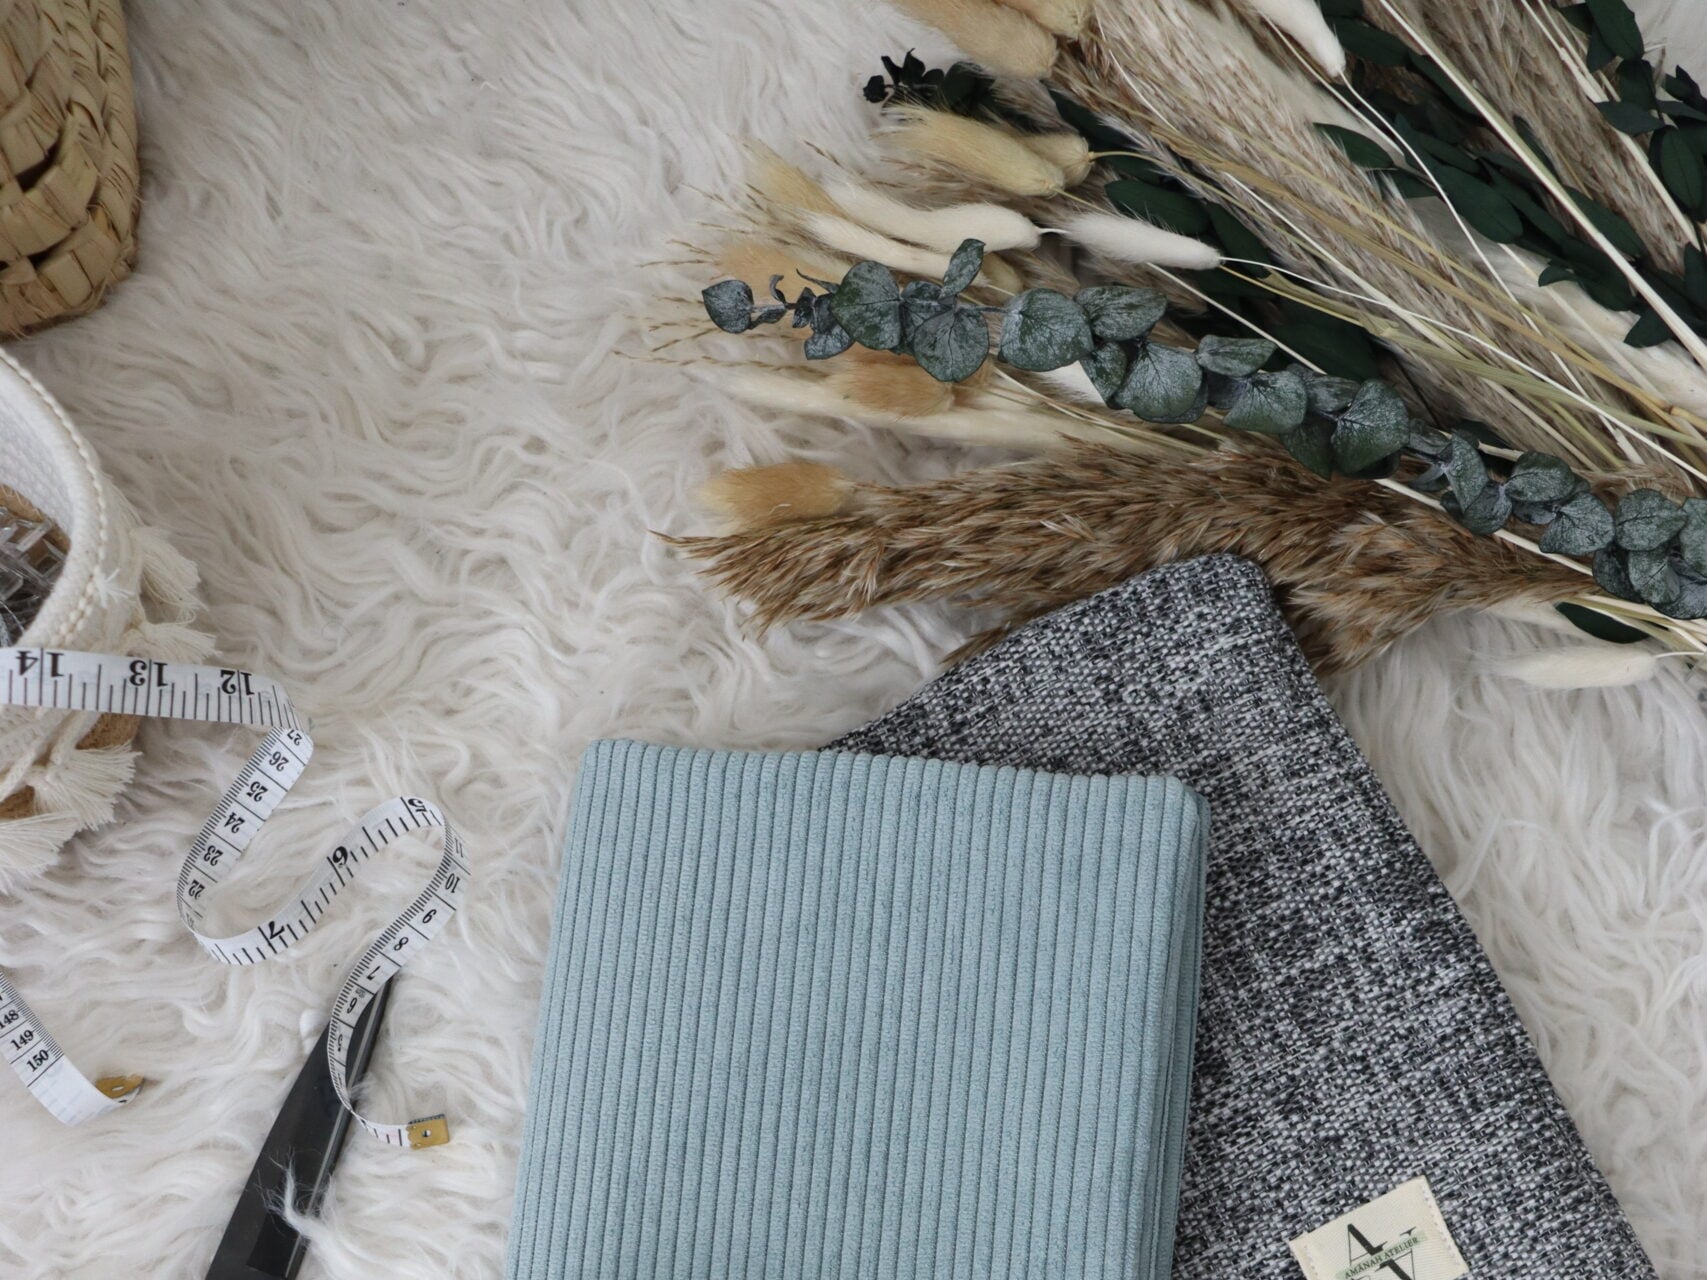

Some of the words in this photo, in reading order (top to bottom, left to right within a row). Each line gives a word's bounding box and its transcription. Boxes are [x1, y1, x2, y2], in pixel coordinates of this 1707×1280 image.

[16, 651, 64, 678] 14
[129, 659, 169, 687] 13
[220, 669, 255, 696] 12
[287, 729, 302, 746] 27
[269, 751, 289, 772] 26
[246, 781, 268, 802] 25
[224, 812, 245, 833] 24
[203, 845, 223, 866] 23
[188, 879, 205, 900] 22
[445, 873, 461, 894] 10
[268, 920, 285, 939] 7
[393, 936, 409, 951] 8
[10, 1029, 34, 1051] 149
[26, 1049, 49, 1072] 150
[1383, 1236, 1420, 1259] ATELIER
